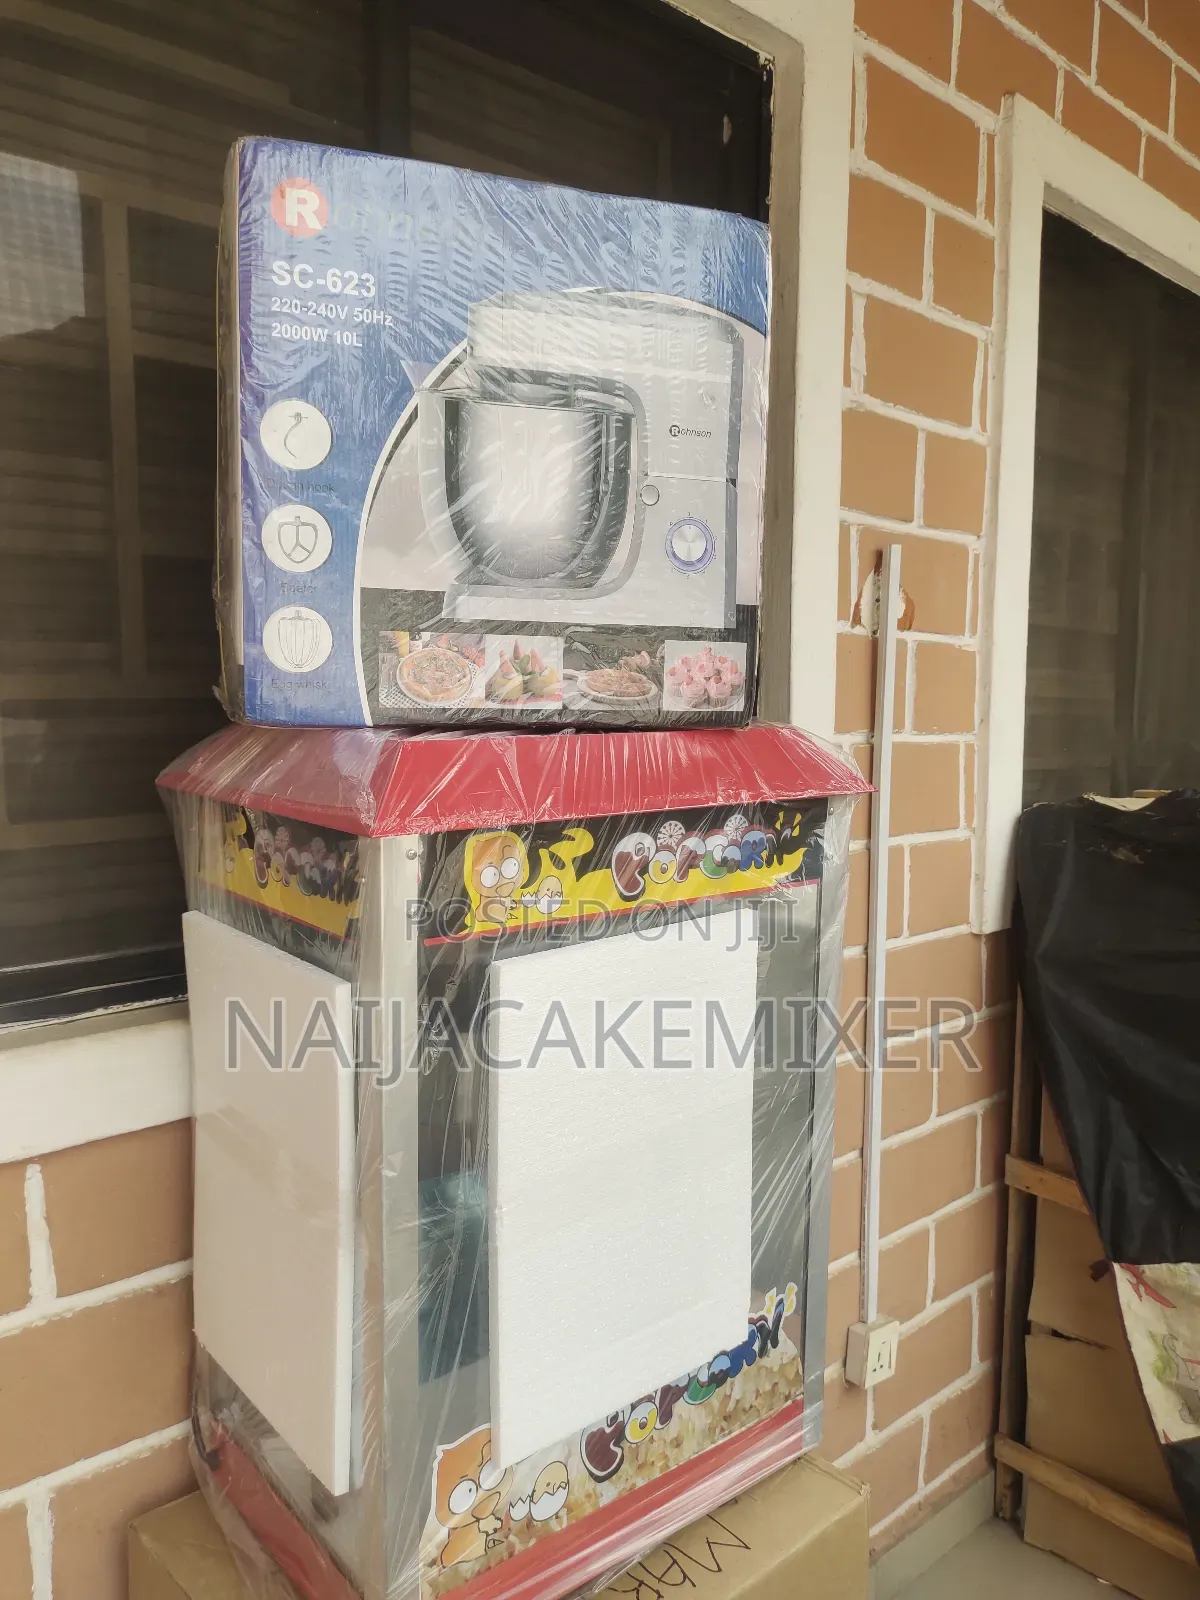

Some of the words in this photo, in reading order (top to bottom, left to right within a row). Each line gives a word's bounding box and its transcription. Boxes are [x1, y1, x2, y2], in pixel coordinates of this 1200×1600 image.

[271, 261, 376, 298] SC-623
[271, 297, 349, 320] 220-240V
[353, 308, 394, 327] 50Hz
[271, 322, 328, 343] 2000W
[334, 328, 363, 347] 10L
